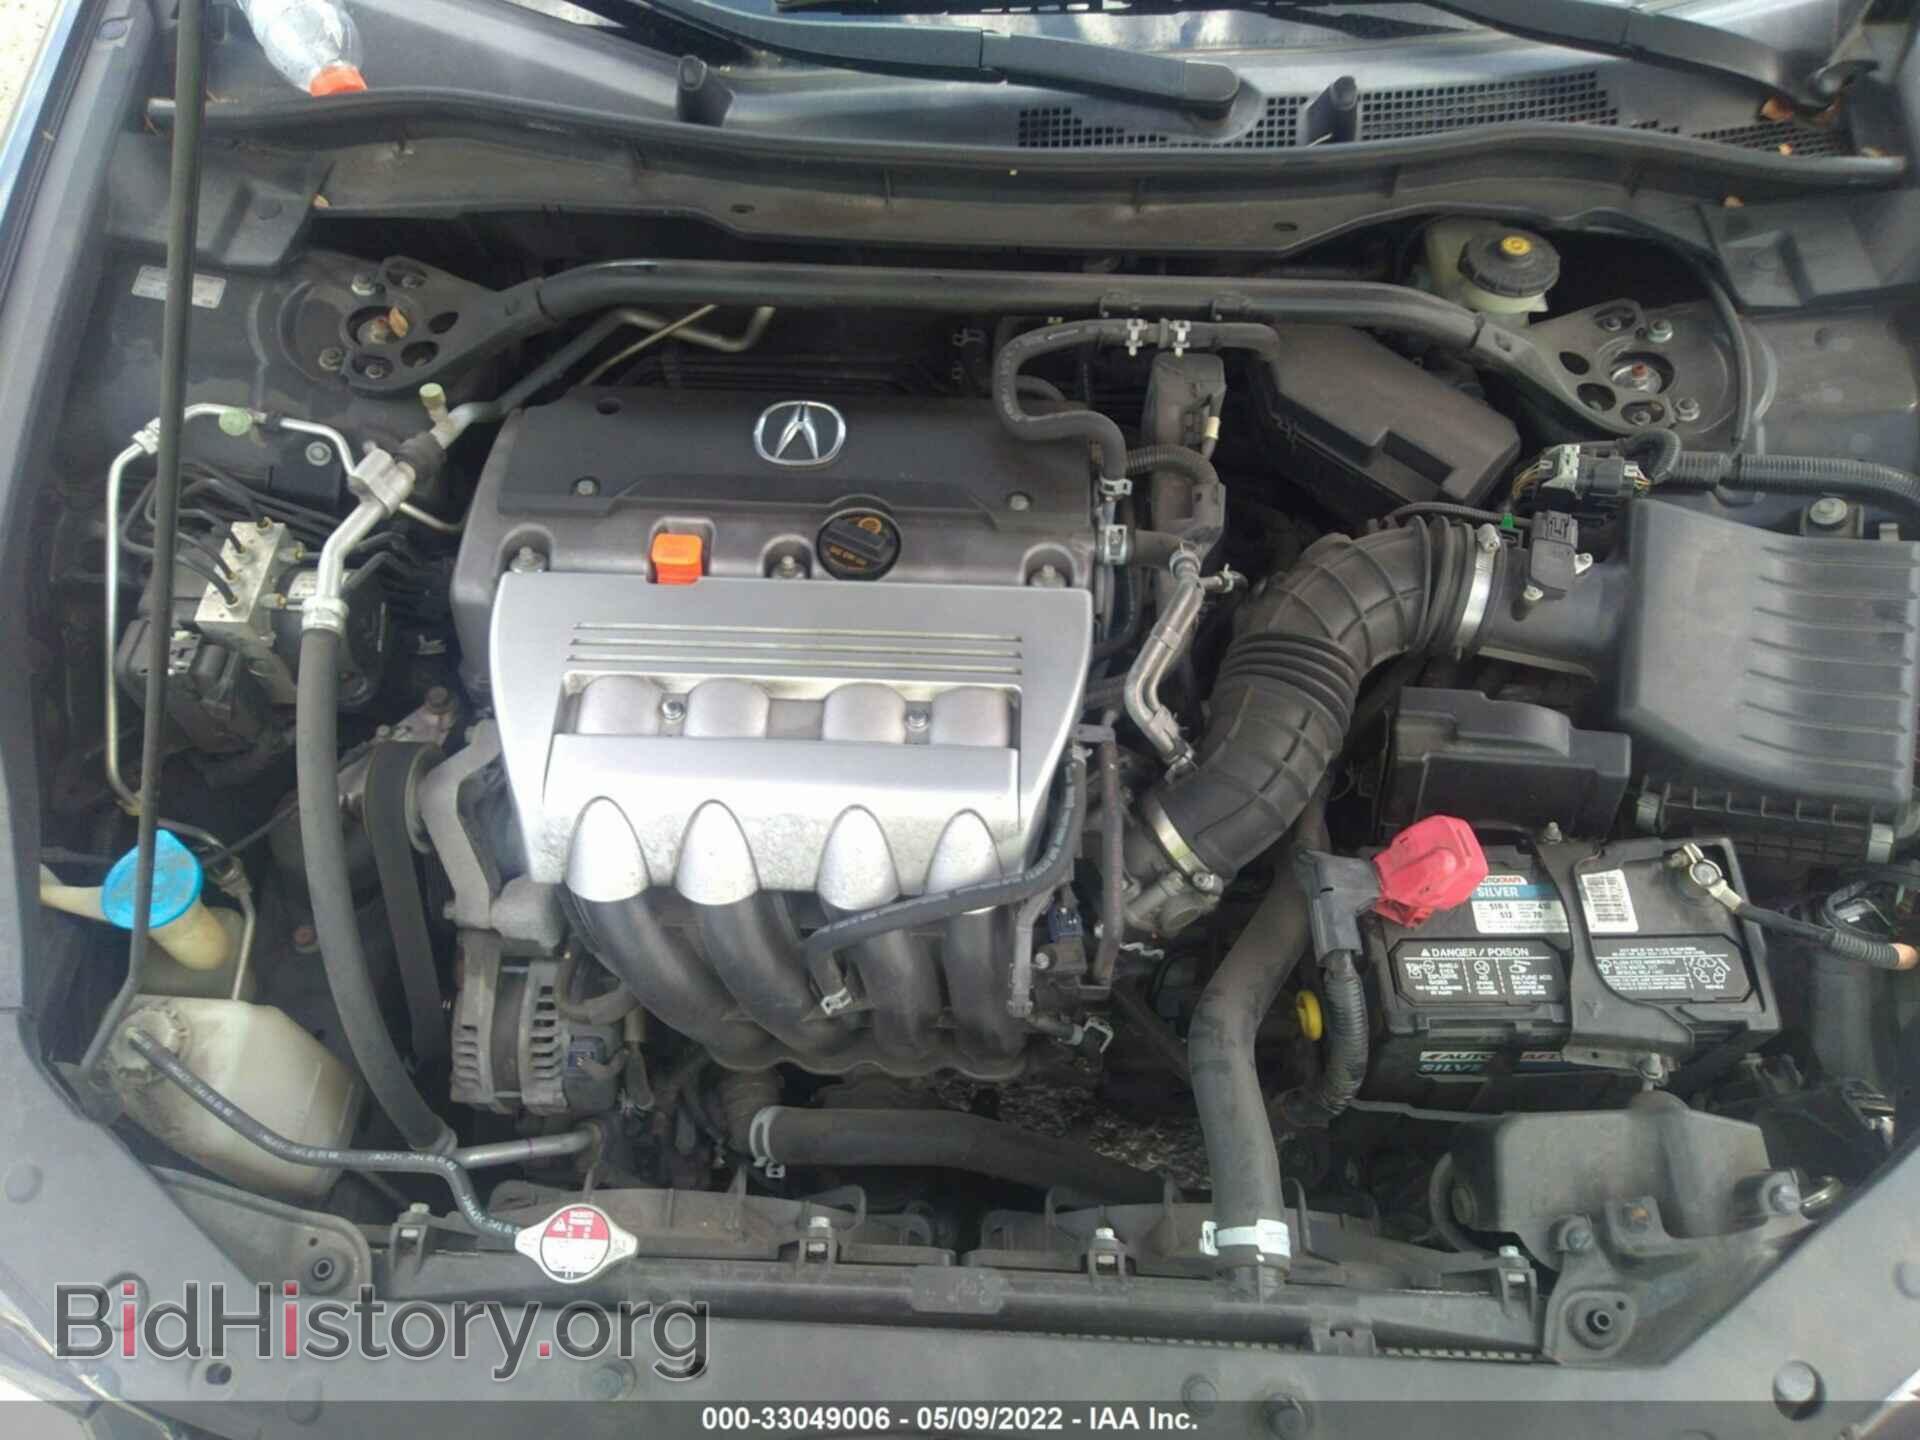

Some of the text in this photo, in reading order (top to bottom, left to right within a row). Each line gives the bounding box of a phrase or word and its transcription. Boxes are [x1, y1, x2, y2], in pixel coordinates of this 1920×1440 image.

[1477, 886, 1518, 897] SILVER
[1431, 948, 1477, 957] DANGER
[1487, 947, 1529, 957] POISON
